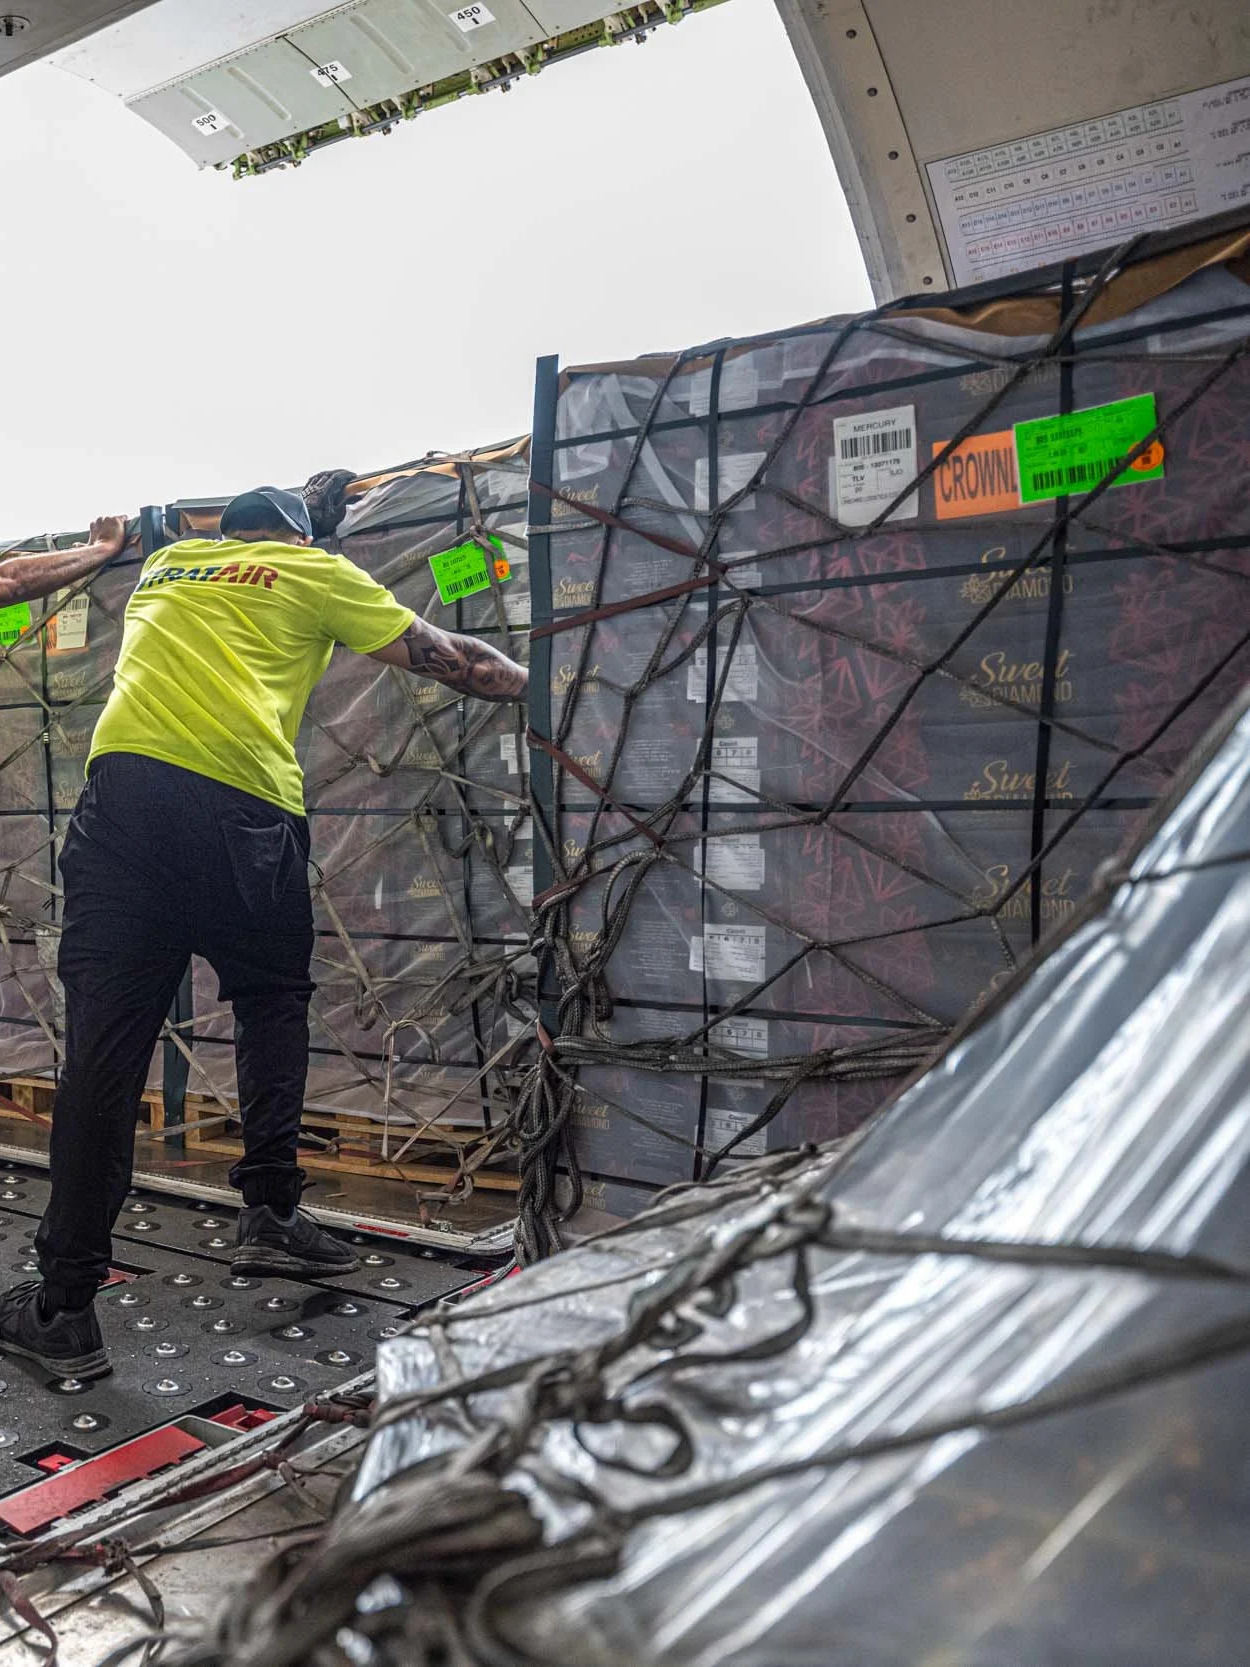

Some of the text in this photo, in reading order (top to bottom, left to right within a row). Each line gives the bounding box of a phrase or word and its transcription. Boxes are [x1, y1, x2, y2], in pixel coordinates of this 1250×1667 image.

[457, 6, 481, 20] 450
[318, 64, 338, 76] 475
[196, 114, 216, 126] 500
[853, 418, 896, 433] MERCURY
[852, 474, 865, 482] TLV
[980, 649, 1076, 688] Swet
